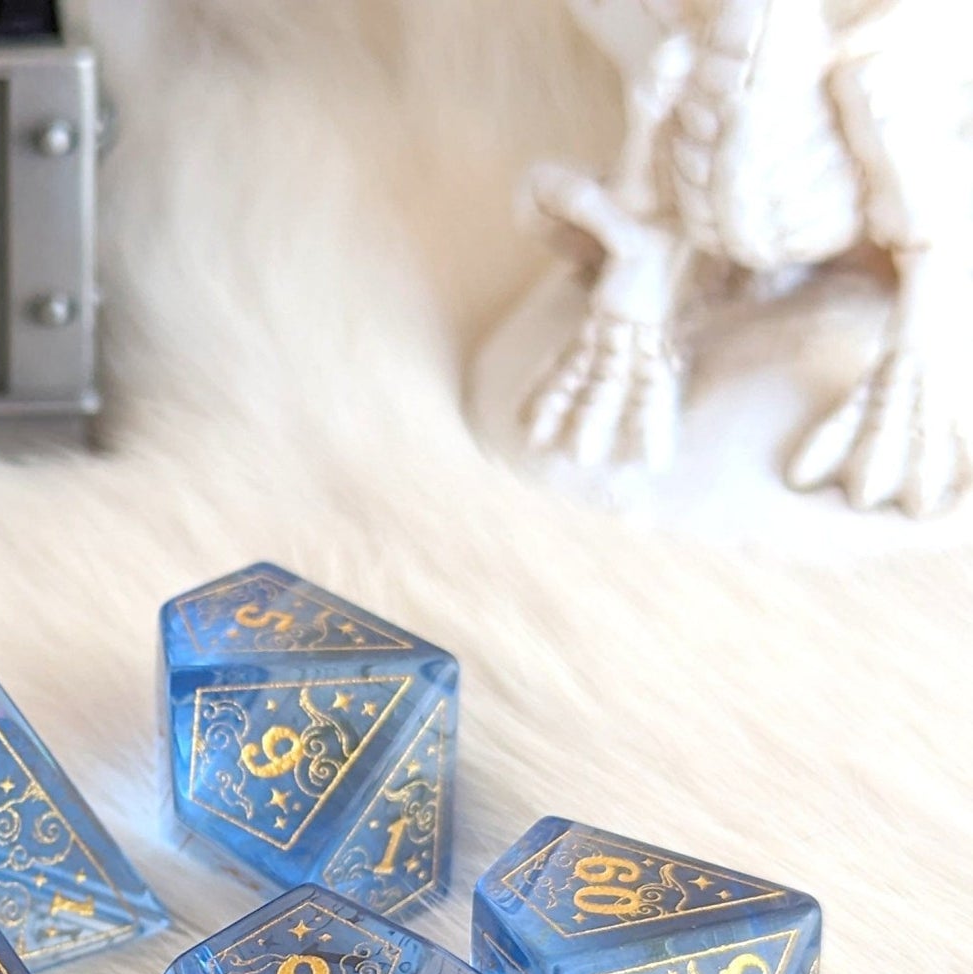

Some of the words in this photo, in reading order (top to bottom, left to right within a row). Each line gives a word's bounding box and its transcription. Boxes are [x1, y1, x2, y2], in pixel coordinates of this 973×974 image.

[240, 726, 304, 778] 9
[373, 817, 410, 875] 1
[573, 855, 641, 915] 60
